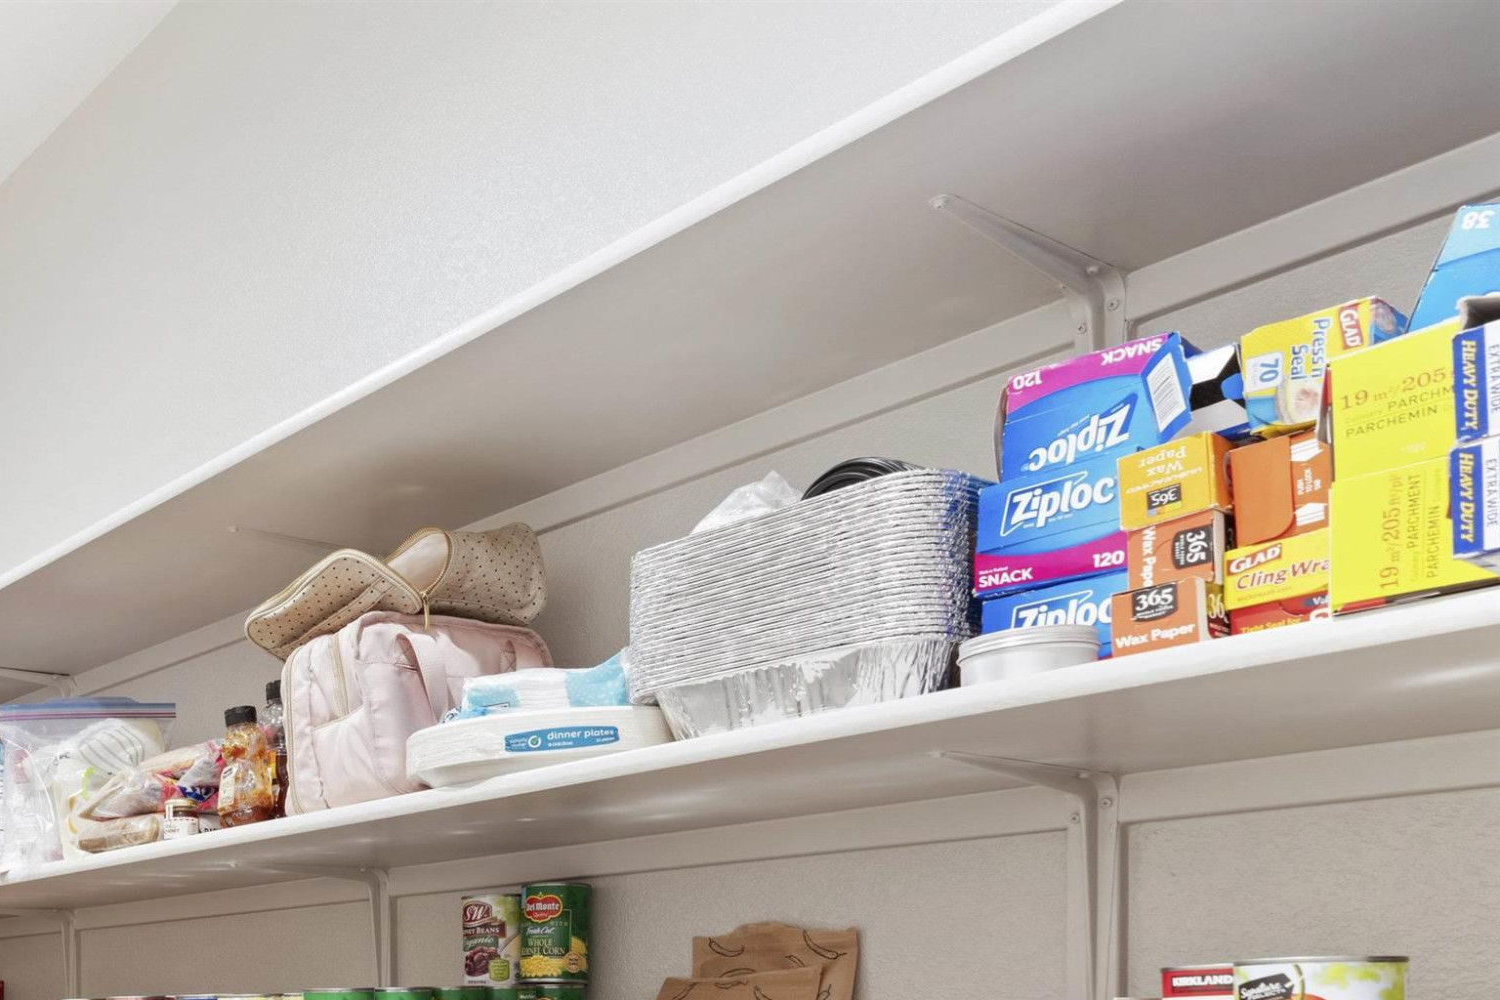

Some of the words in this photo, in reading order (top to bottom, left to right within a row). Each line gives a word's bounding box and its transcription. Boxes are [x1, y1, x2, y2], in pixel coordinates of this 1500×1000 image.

[1339, 309, 1360, 346] GLAD
[1101, 338, 1163, 364] SNACK
[1291, 345, 1308, 380] Seal
[1012, 370, 1042, 390] 120
[1259, 358, 1279, 382] 70
[1462, 340, 1477, 392] HEAVY
[1345, 404, 1438, 439] PARCHEMIN
[1463, 392, 1481, 430] DUTY
[1027, 403, 1132, 472] Ziploc
[1138, 447, 1187, 469] Paper
[1146, 460, 1184, 477] Wax
[1458, 453, 1474, 502] HEAVY
[1486, 458, 1497, 495] EXTRA
[1011, 477, 1115, 528] Ziploc
[1151, 488, 1177, 506] 365
[1406, 474, 1420, 548] PARCHMENT
[1460, 502, 1475, 543] DUTY
[1487, 498, 1498, 526] WIDE
[1186, 531, 1206, 563] 365
[1427, 505, 1440, 578] PARCHEMIN
[1093, 550, 1125, 568] 120
[1229, 545, 1280, 574] GLAD
[979, 568, 1033, 588] SNACK
[1236, 568, 1286, 590] Cling
[1290, 559, 1329, 578] Wra
[1135, 587, 1174, 613] 365
[1115, 633, 1148, 649] Wax
[1151, 624, 1195, 643] Paper
[547, 731, 581, 740] dinner
[584, 729, 613, 738] plates
[528, 938, 553, 946] WHOLE
[1172, 976, 1233, 986] KIRKLAND
